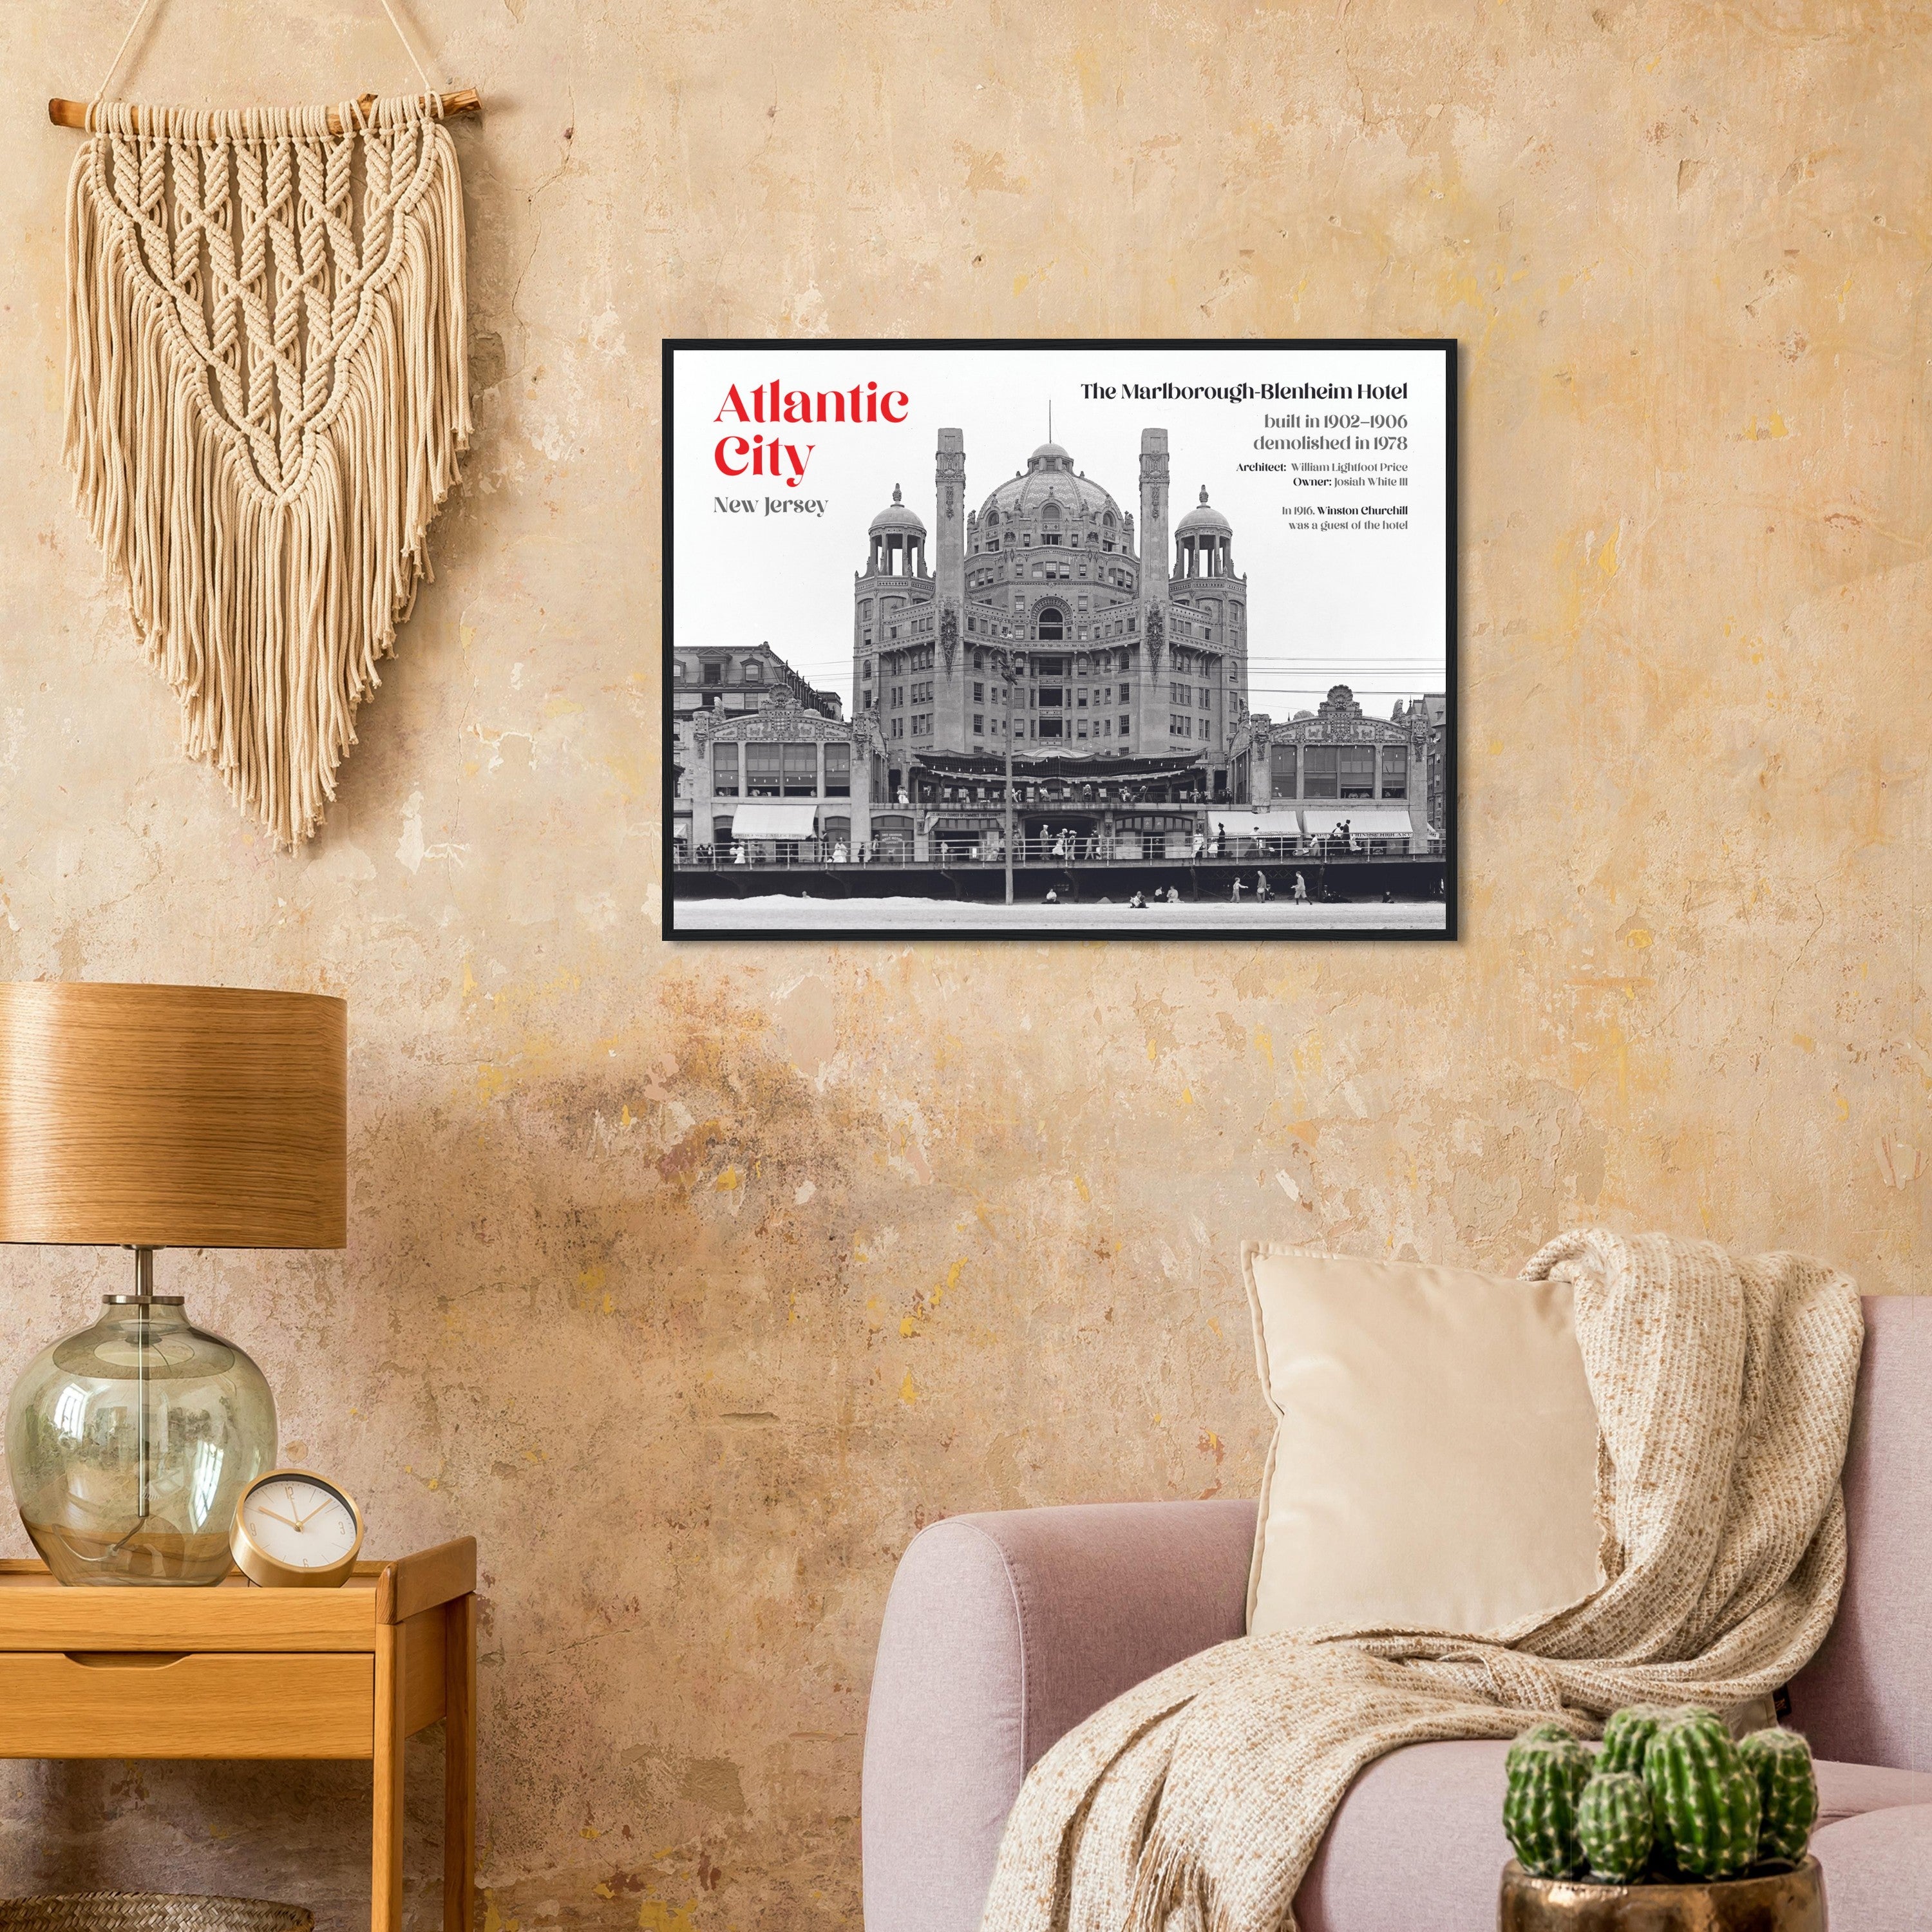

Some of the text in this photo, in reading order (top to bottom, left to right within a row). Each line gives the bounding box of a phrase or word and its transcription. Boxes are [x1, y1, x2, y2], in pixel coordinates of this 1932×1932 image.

[1081, 382, 1408, 404] The Marlborough-Blenheim Hotel
[714, 379, 909, 423] Atlantic
[1265, 413, 1300, 428] built
[1305, 414, 1320, 428] in
[1253, 435, 1408, 450] demolished in 1978
[714, 434, 816, 488] City
[1236, 462, 1408, 474] Architect: William Lightfoot Price
[1293, 477, 1408, 488] Owner: Josiah White III
[714, 497, 829, 518] New Jersey
[1282, 506, 1292, 515] In
[1317, 506, 1359, 515] Winston
[1361, 506, 1408, 515] Churchill
[1289, 522, 1309, 530] was
[1320, 520, 1349, 532] guest
[1351, 520, 1361, 530] of
[1364, 520, 1380, 530] the
[1383, 520, 1408, 530] hotel
[284, 1486, 295, 1500] 12
[250, 1522, 258, 1537] 9
[338, 1520, 345, 1535] 3
